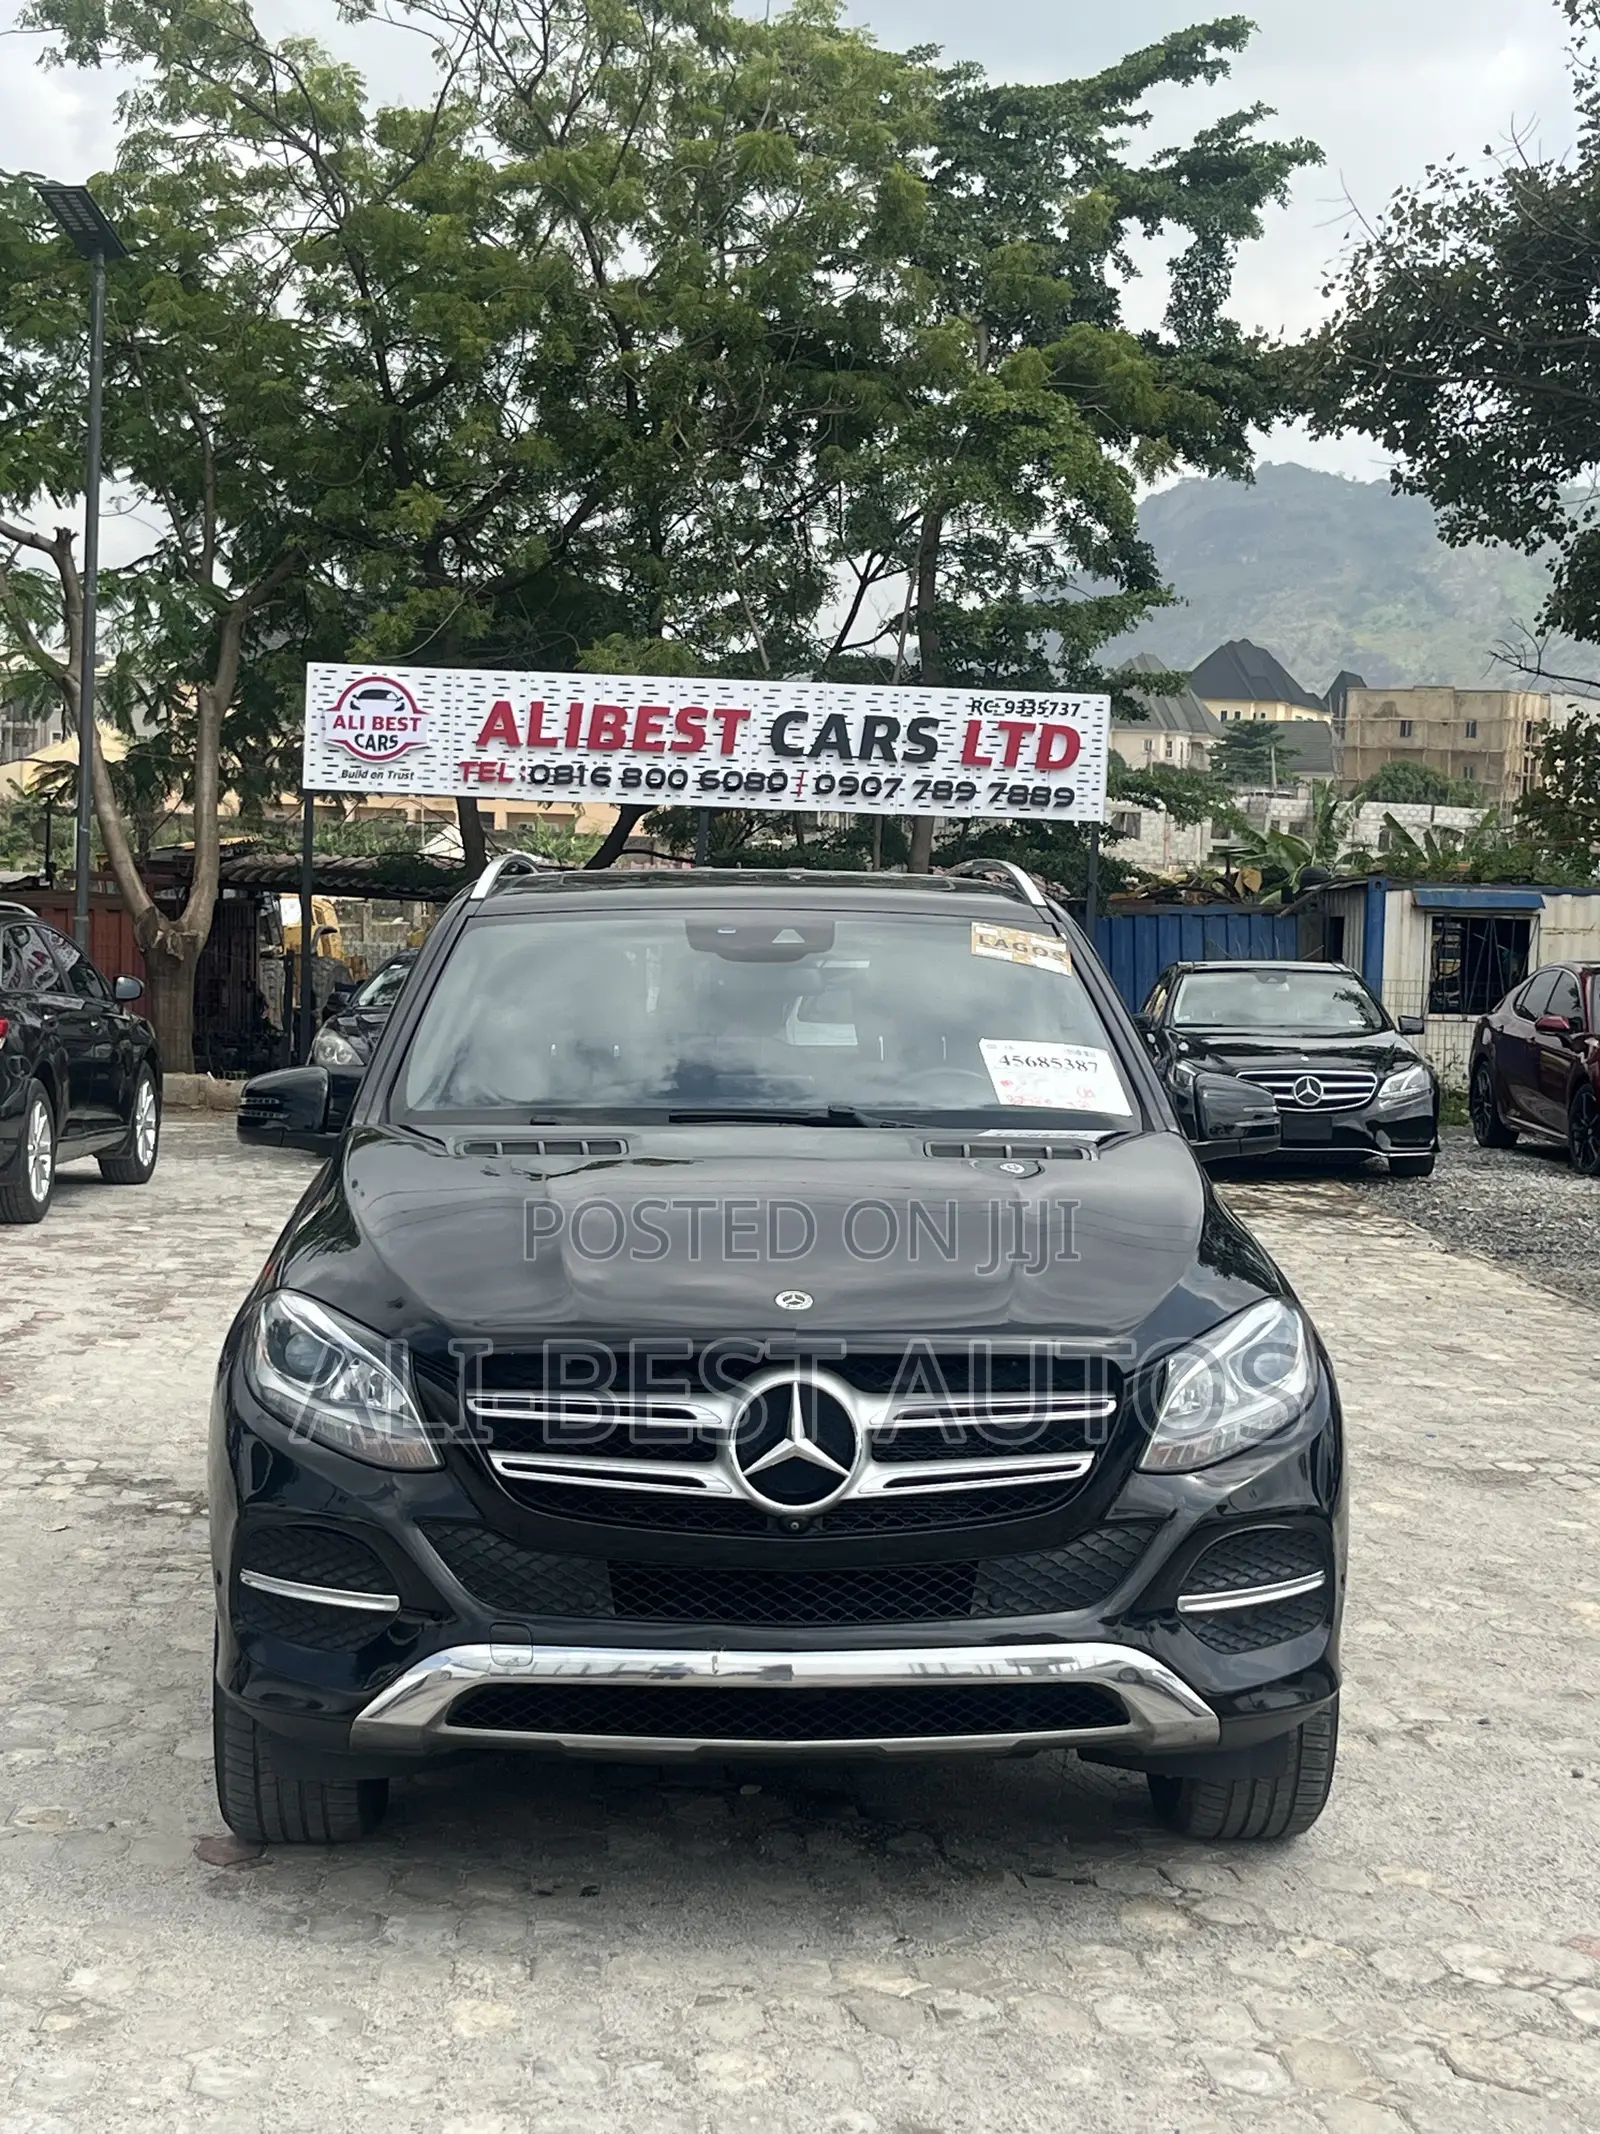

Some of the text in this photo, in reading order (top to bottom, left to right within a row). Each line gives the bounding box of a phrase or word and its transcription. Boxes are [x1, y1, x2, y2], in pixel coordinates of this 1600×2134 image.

[1004, 700, 1081, 717] 9335737
[333, 714, 422, 732] ALI BEST
[354, 733, 398, 752] CARS
[476, 700, 1081, 770] ALIBEST CARS LTD
[341, 769, 369, 779] Build
[387, 770, 415, 781] Trust
[529, 763, 612, 787] 0816
[621, 767, 689, 790] 800
[699, 769, 788, 793] 6080
[814, 773, 903, 800] 0907
[912, 778, 977, 801] 789
[987, 782, 1076, 808] 7889
[979, 935, 1065, 962] LAGOS
[999, 1054, 1098, 1073] 45685387
